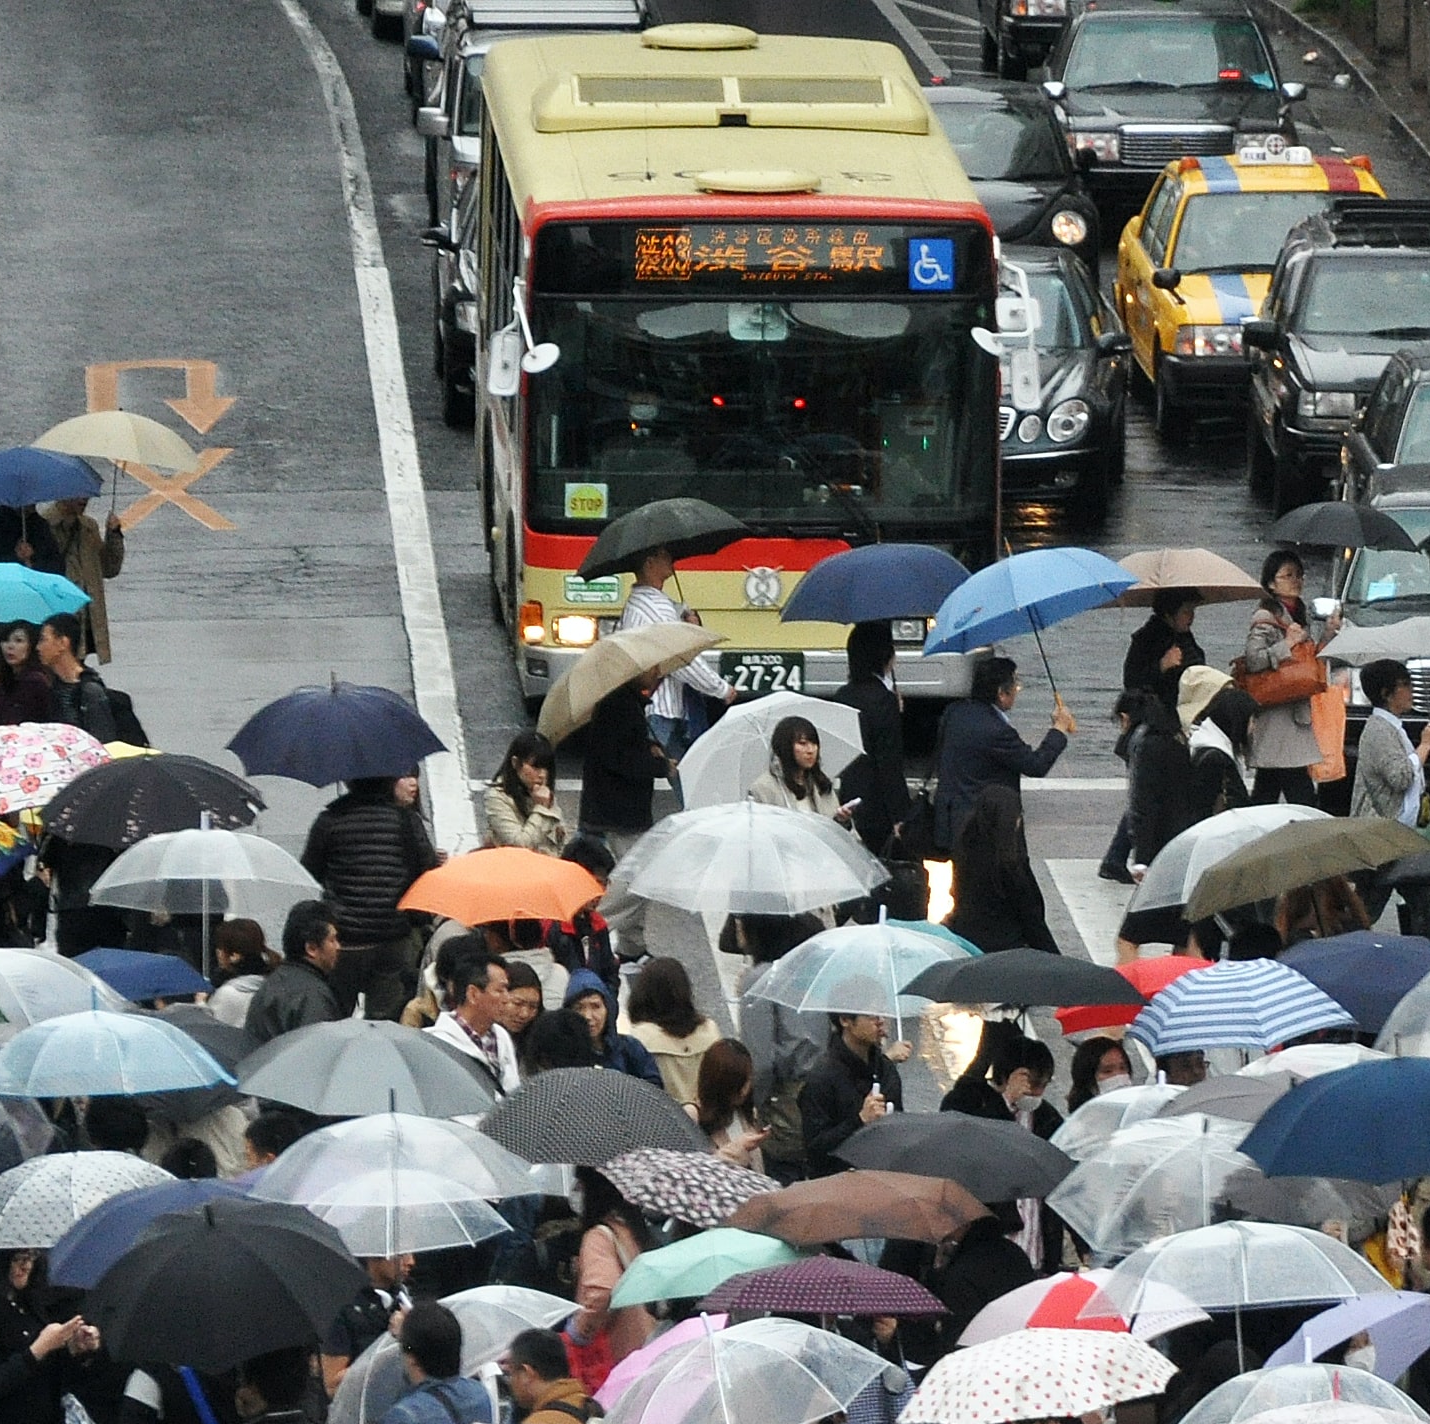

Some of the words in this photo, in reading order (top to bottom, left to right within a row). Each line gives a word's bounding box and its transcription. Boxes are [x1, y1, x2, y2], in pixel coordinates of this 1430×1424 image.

[693, 245, 884, 272] 渋谷駅
[570, 497, 604, 511] STOP
[734, 665, 802, 691] 27-24
